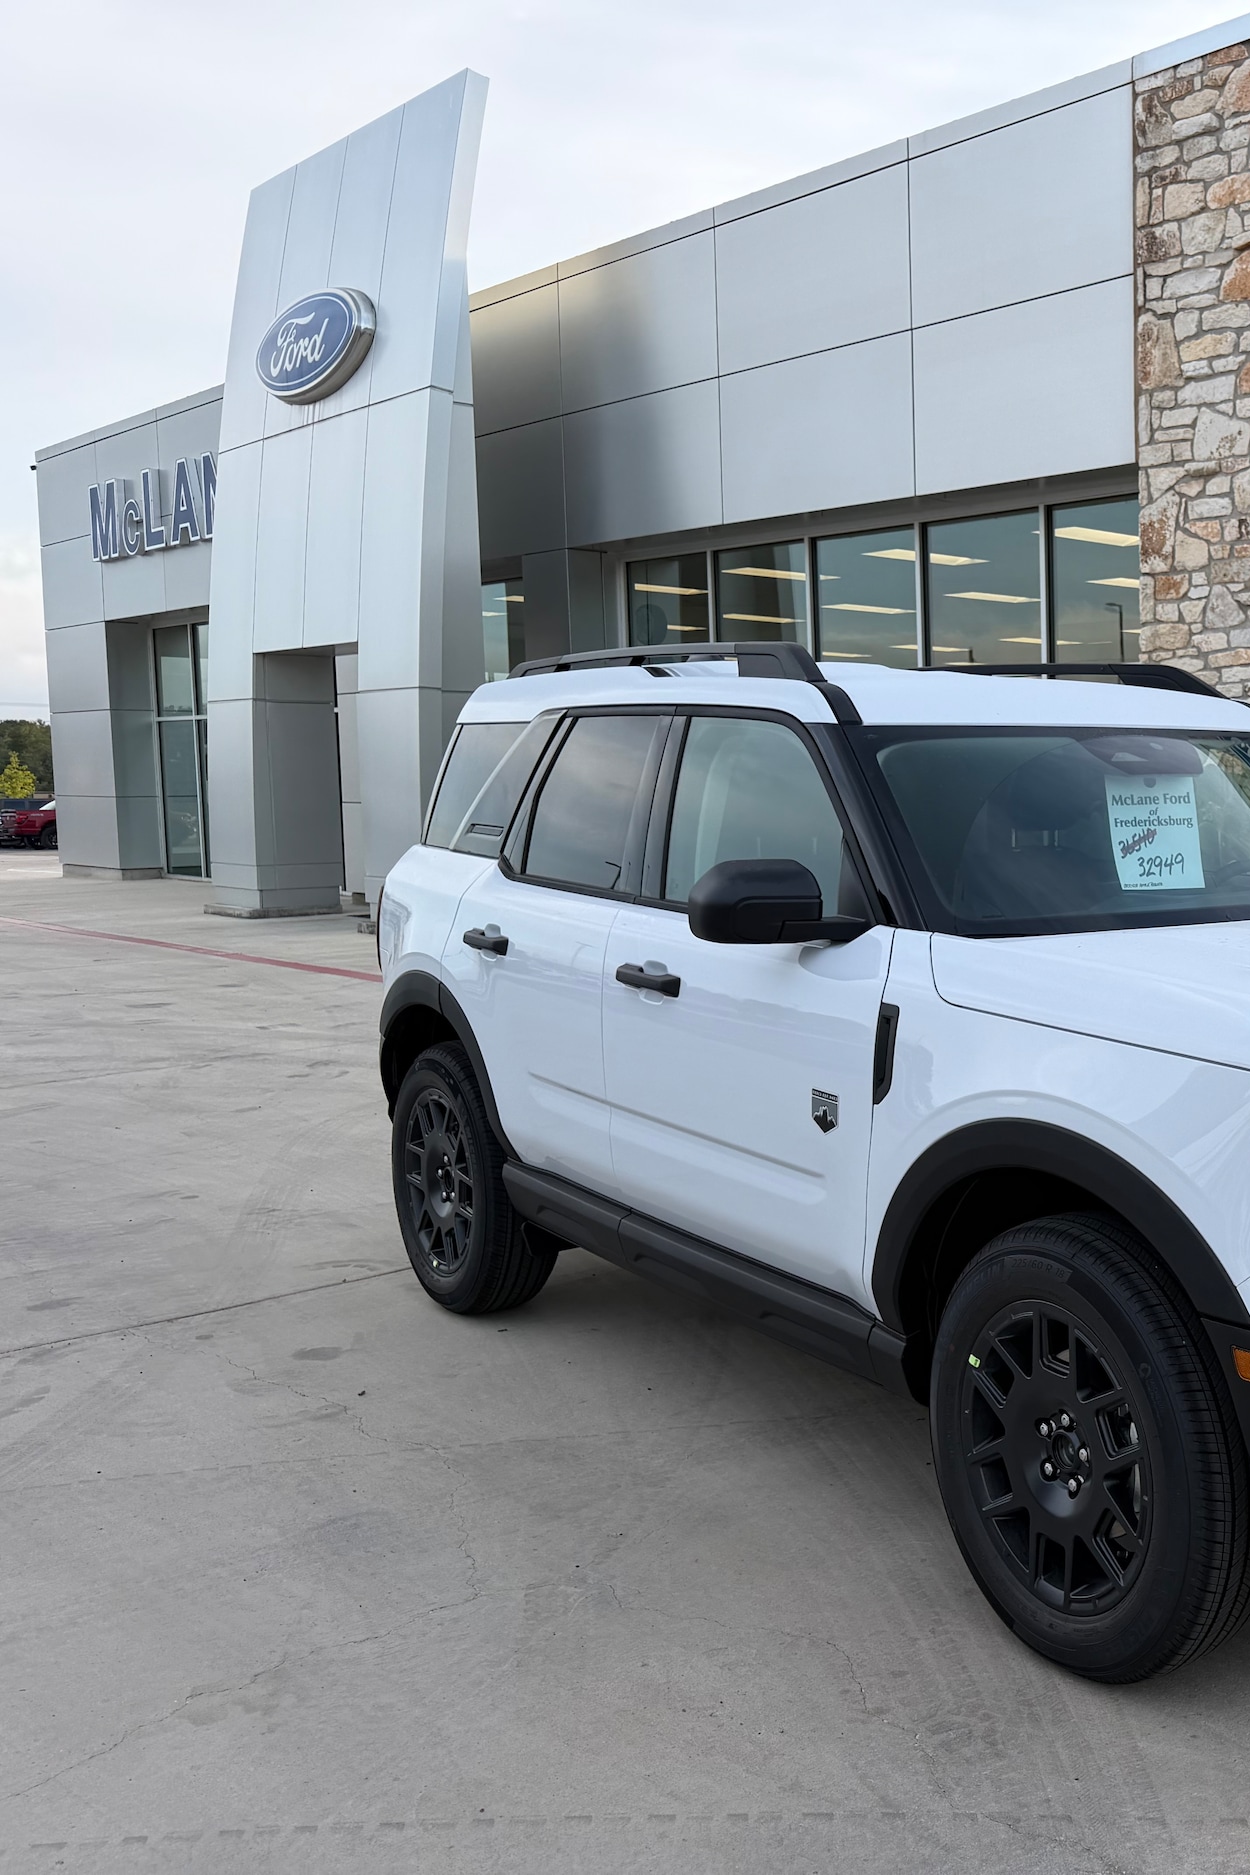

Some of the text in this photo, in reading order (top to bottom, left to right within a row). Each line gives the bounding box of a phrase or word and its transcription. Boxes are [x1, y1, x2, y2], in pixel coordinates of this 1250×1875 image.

[270, 311, 329, 378] Ford
[1112, 792, 1191, 806] McLane Ford
[1149, 807, 1159, 816] of
[1114, 816, 1194, 828] Fredericksburg
[1137, 853, 1185, 877] 32949
